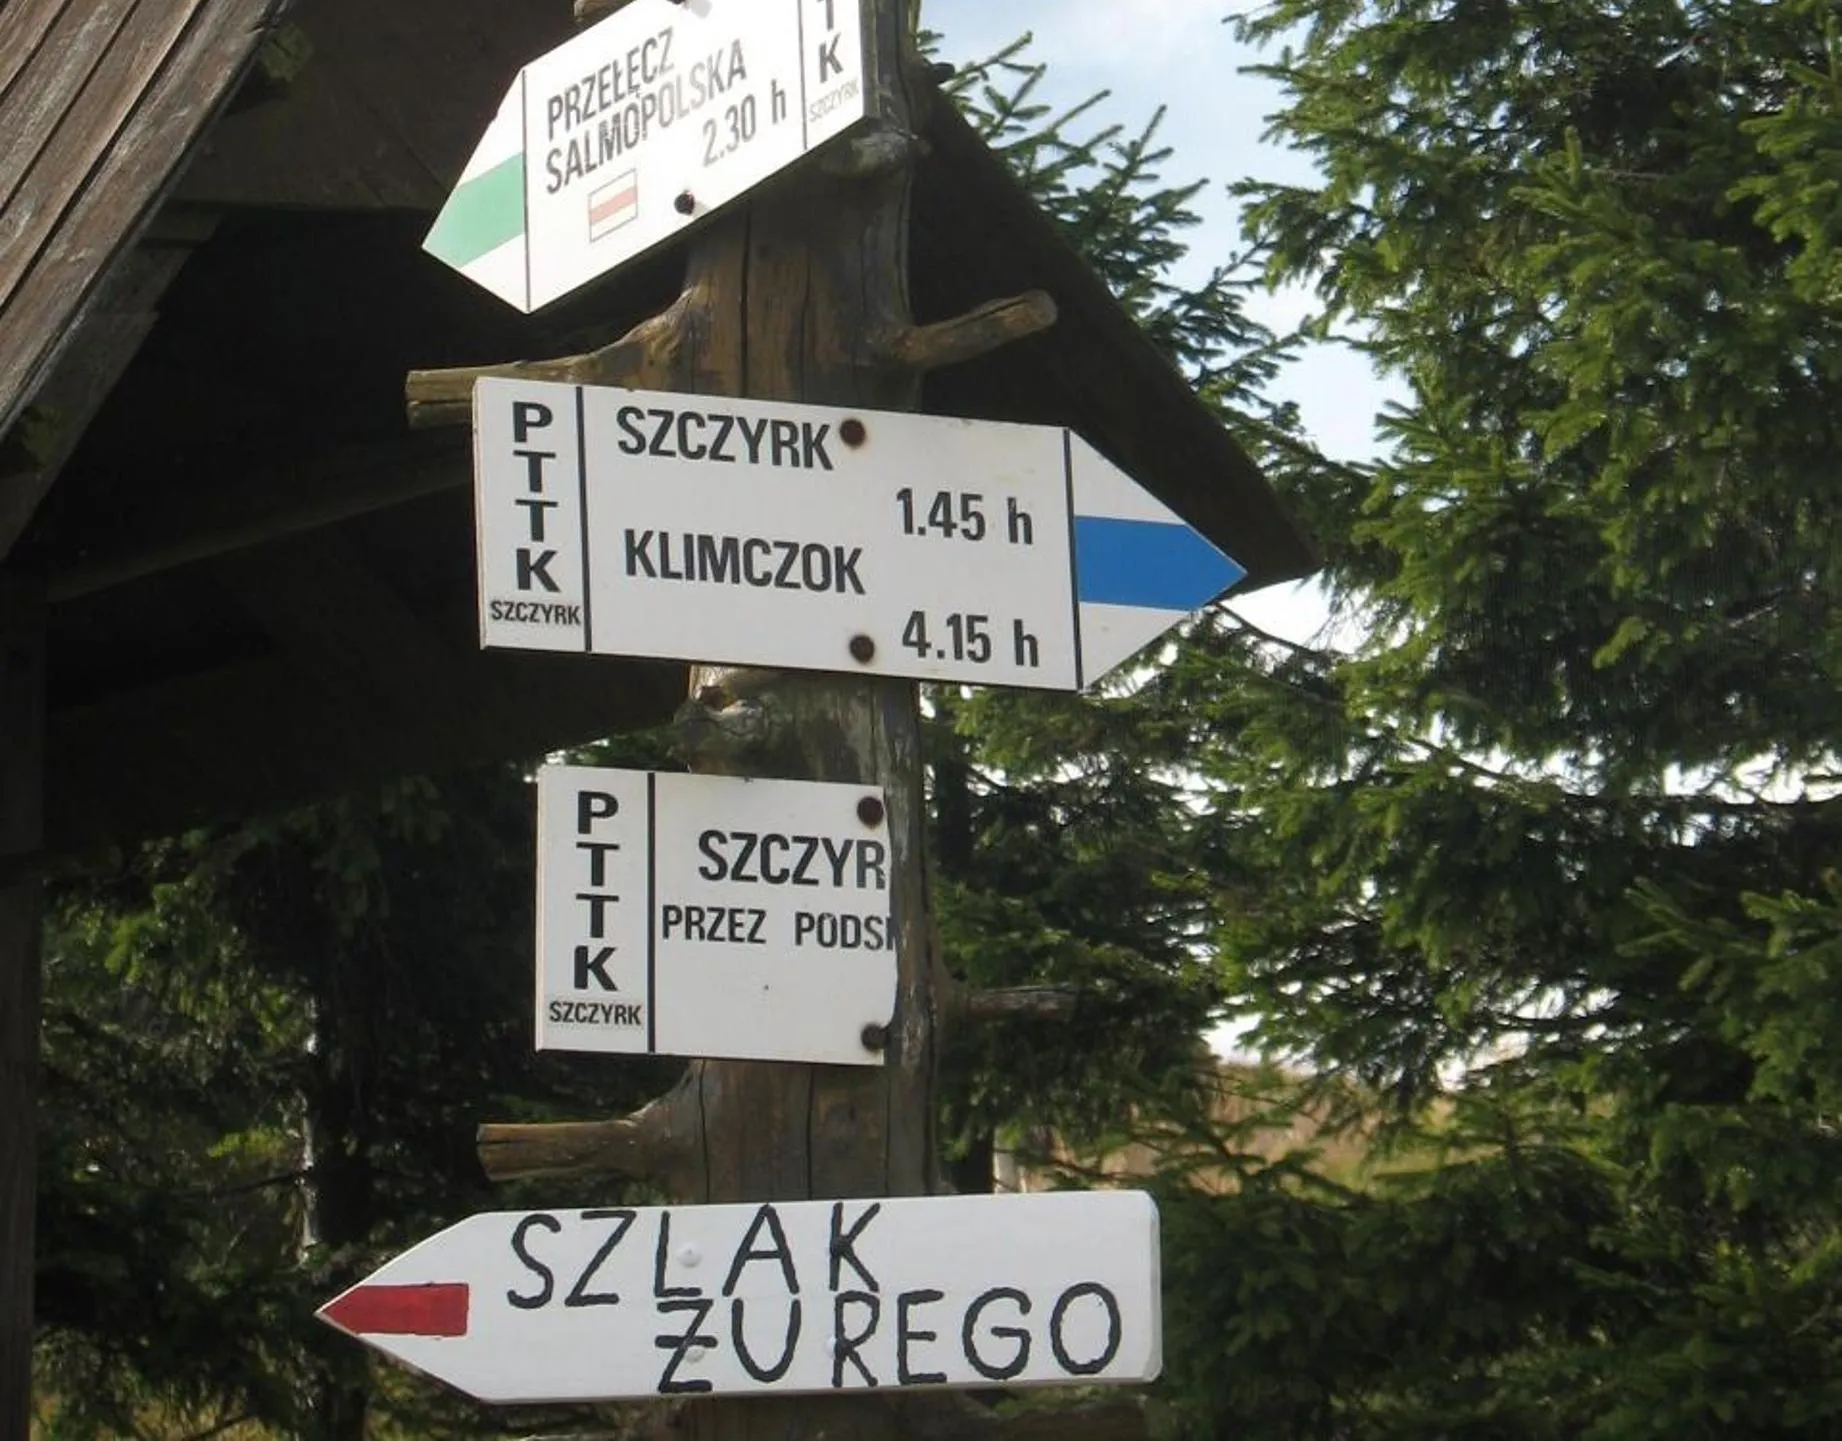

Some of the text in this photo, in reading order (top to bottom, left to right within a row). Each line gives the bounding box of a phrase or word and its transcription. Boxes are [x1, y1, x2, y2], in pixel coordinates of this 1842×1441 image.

[547, 26, 675, 142] PRZEŁĘCZ
[809, 77, 860, 124] SZCZYRK
[545, 38, 747, 196] SALMOPOLSKA
[702, 77, 787, 168] 2.30 h
[616, 406, 834, 471] SZCZYRK
[512, 401, 561, 593] PTTK
[896, 487, 1034, 545] 1.45 h
[624, 529, 866, 595] KLIMCZOK
[490, 600, 582, 627] SZCZYRK
[901, 610, 1040, 668] 4.15 h
[573, 791, 620, 992] PTTK
[698, 830, 887, 890] SZCZYR
[661, 904, 767, 945] PRZEZ
[549, 1000, 642, 1027] SZCZYRK
[506, 1202, 882, 1311] SZLAK
